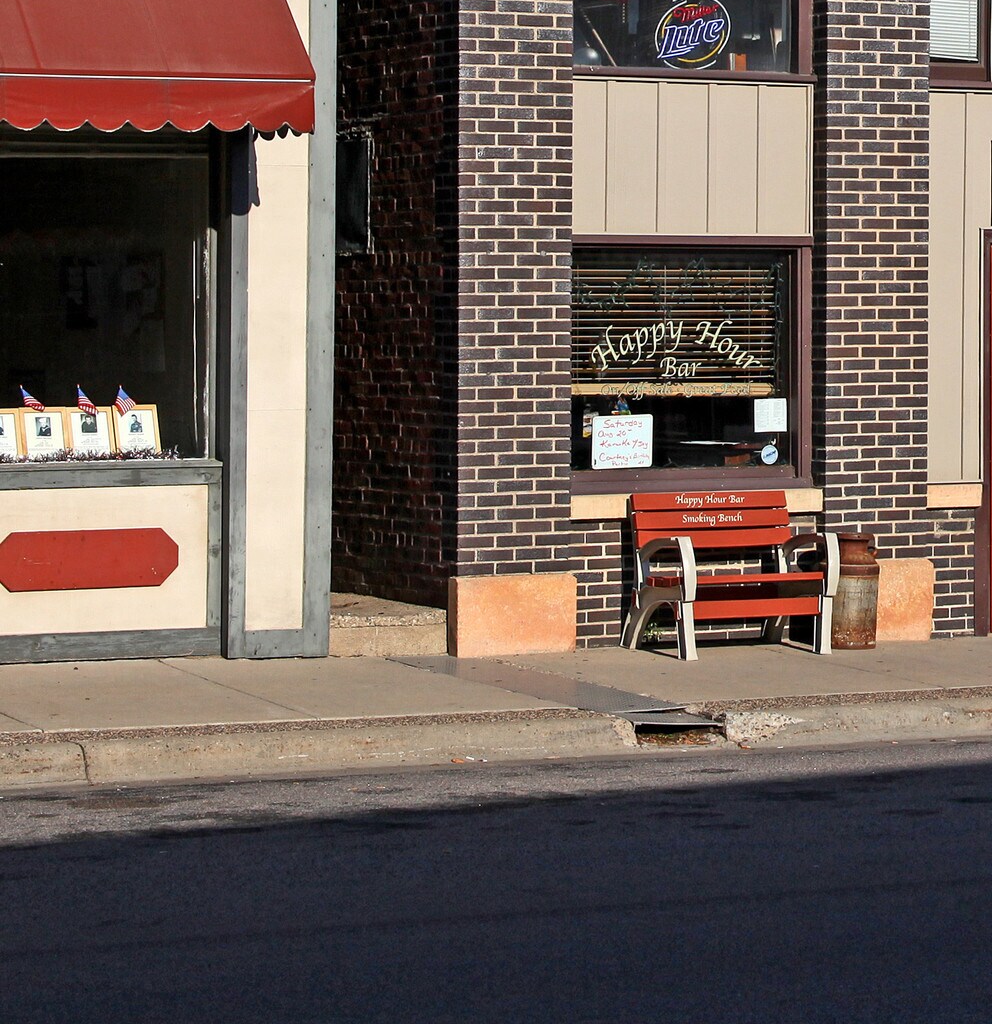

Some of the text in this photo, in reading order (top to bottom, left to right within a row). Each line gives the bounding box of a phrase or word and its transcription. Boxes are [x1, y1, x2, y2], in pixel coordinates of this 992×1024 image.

[591, 320, 764, 372] Happy Hour
[660, 356, 702, 377] Bar
[603, 419, 643, 429] Saturday
[675, 492, 746, 508] Happy Hour Bar
[682, 511, 743, 526] Smoking Bench
